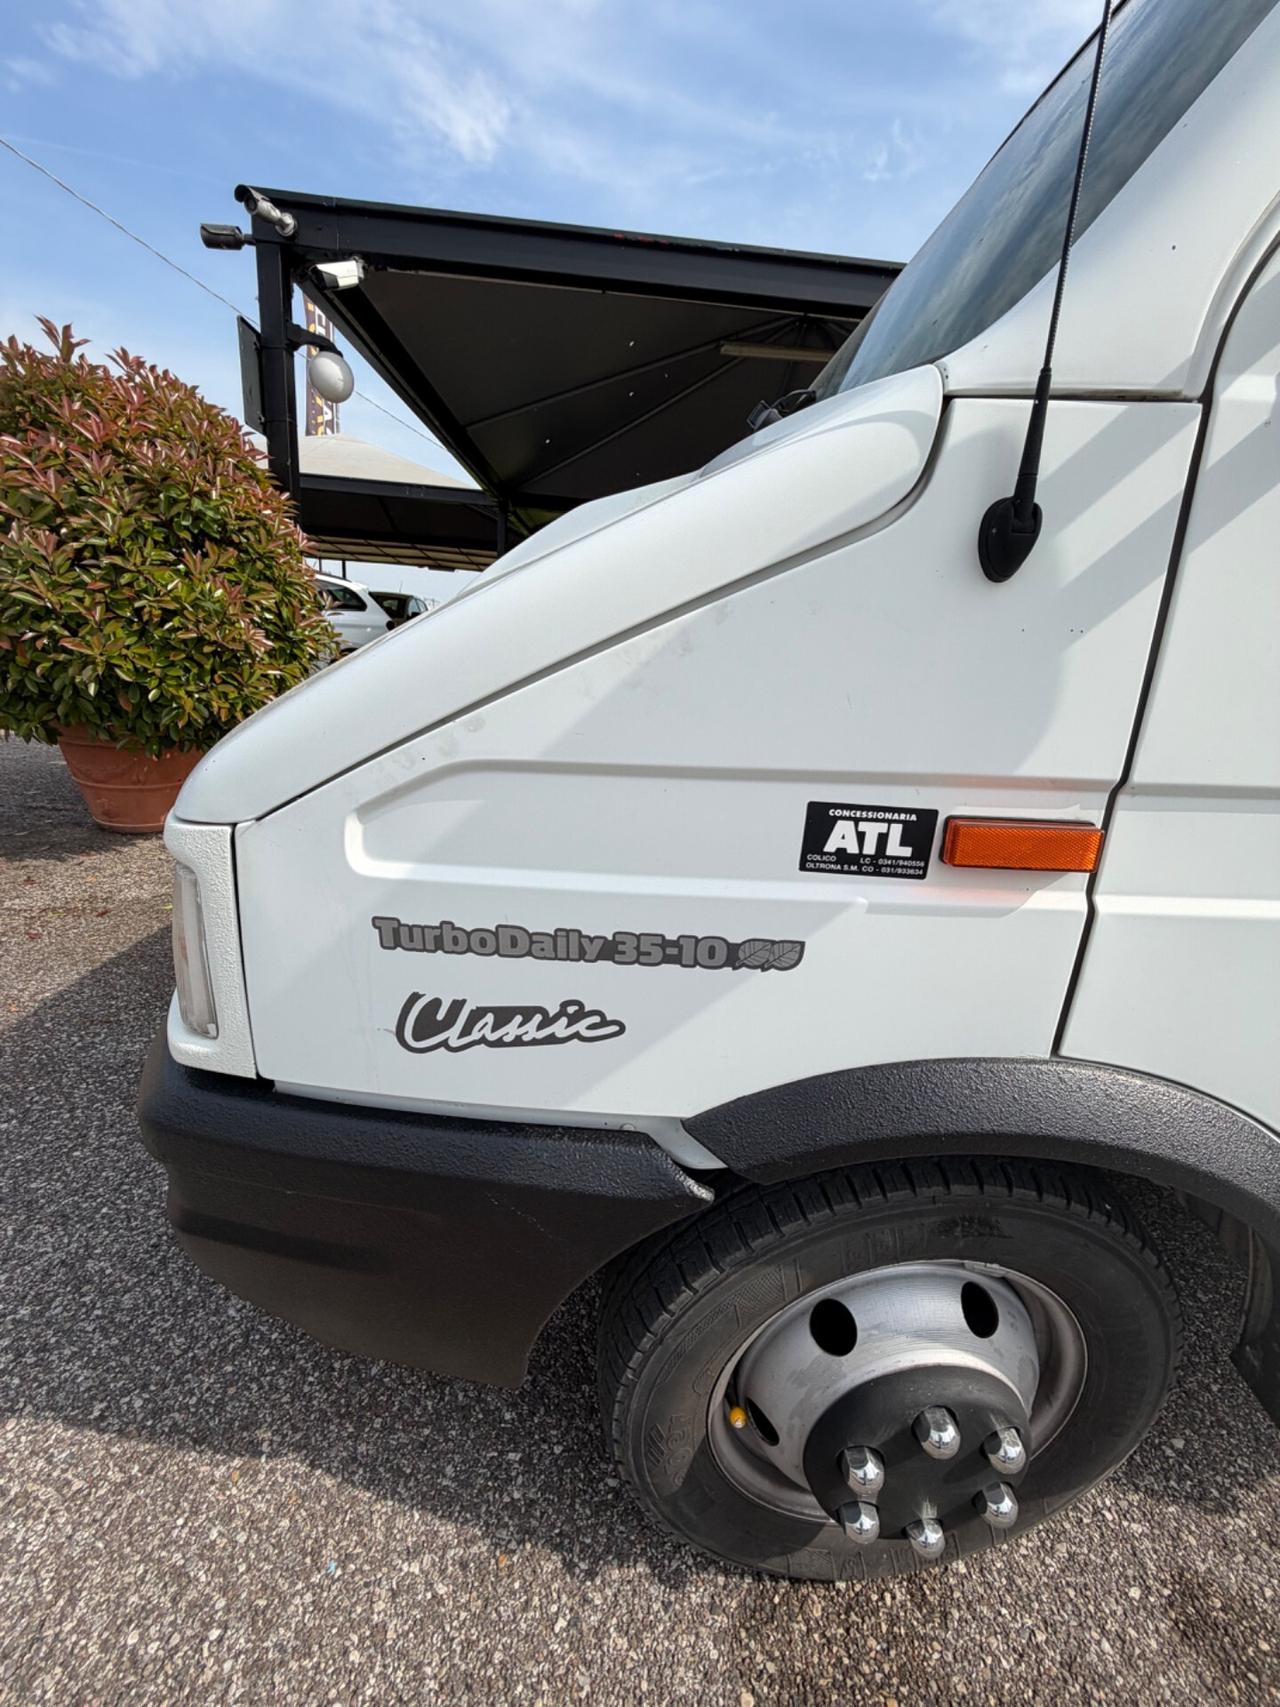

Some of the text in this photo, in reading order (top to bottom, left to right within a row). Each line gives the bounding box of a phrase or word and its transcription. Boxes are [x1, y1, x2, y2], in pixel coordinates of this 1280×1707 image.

[829, 809, 917, 821] CONCESSIONARIA
[823, 820, 913, 857] ATL
[806, 854, 837, 863] COLICO
[859, 857, 871, 865] LC
[806, 862, 841, 871] OLTRONA
[843, 864, 859, 872] S.M.
[861, 865, 874, 873] CO
[373, 916, 728, 969] TurboDaily 35-10
[398, 991, 624, 1052] Classic
